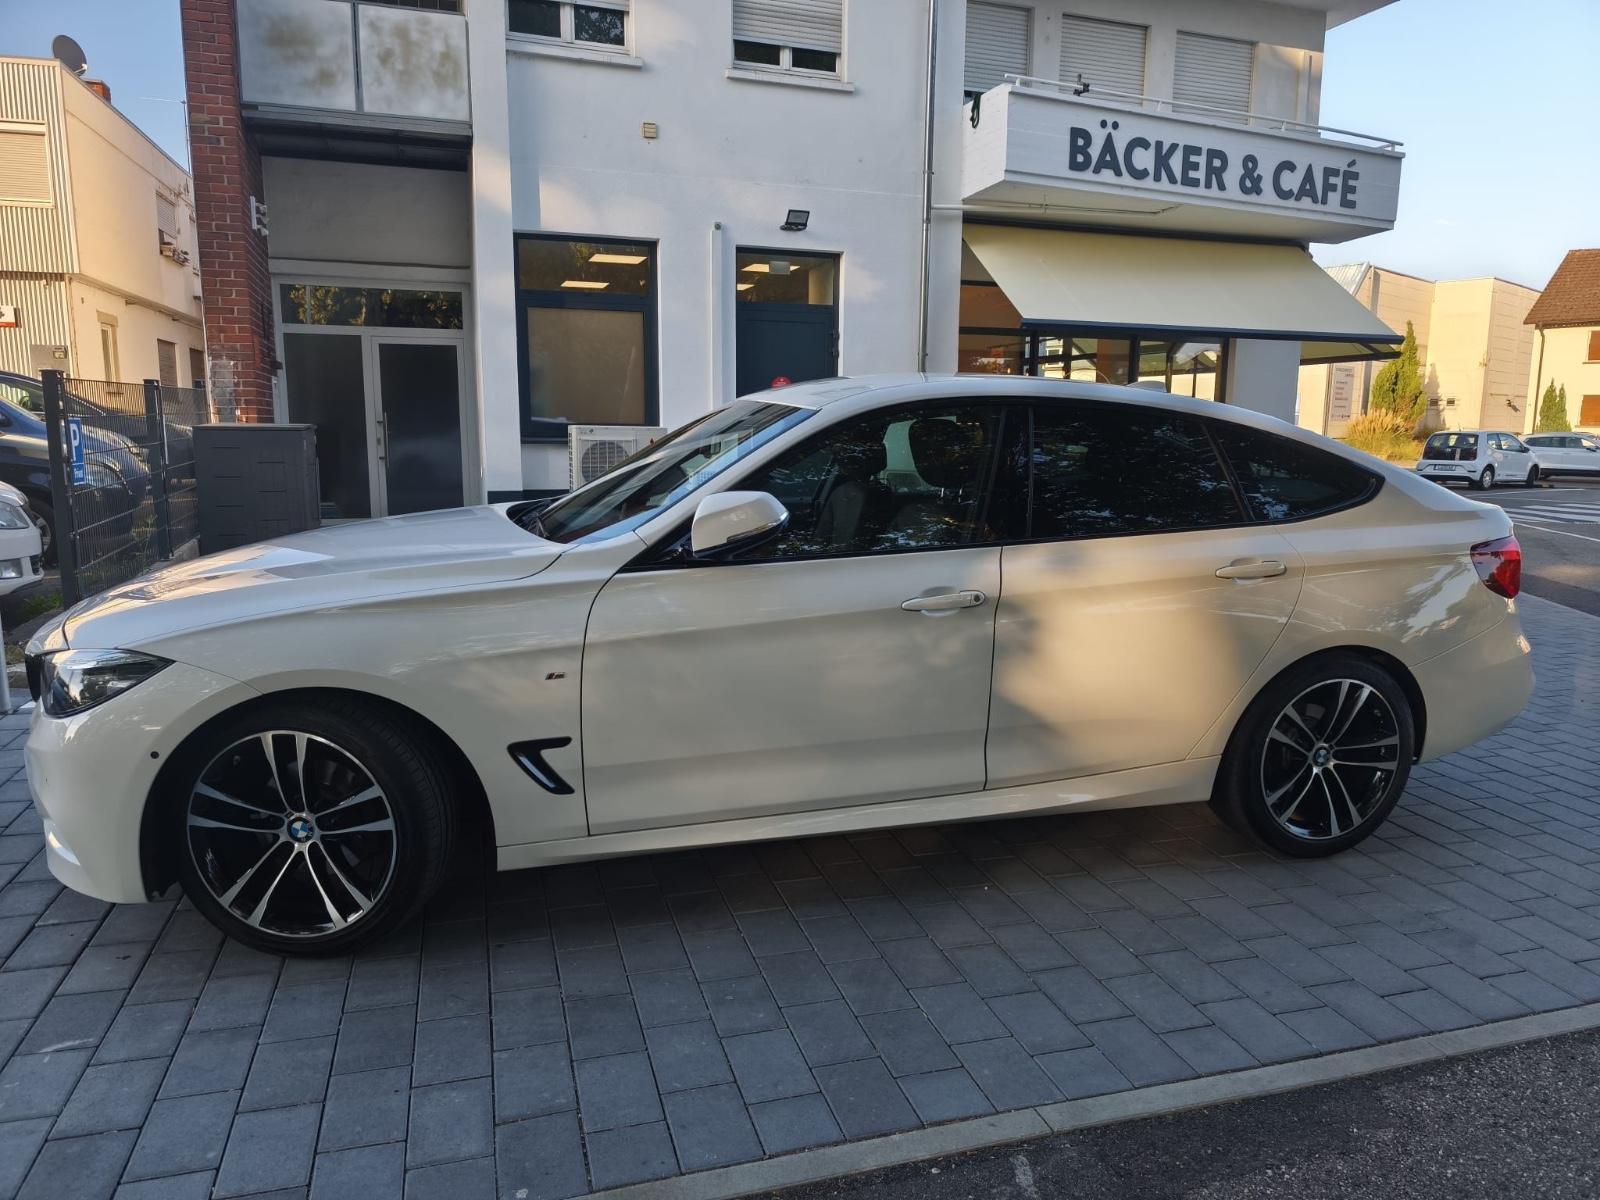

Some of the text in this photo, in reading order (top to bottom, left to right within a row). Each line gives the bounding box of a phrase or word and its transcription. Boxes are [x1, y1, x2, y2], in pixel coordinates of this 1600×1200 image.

[1068, 119, 1360, 209] BÄCKER & CAFÉ
[70, 423, 80, 461] P
